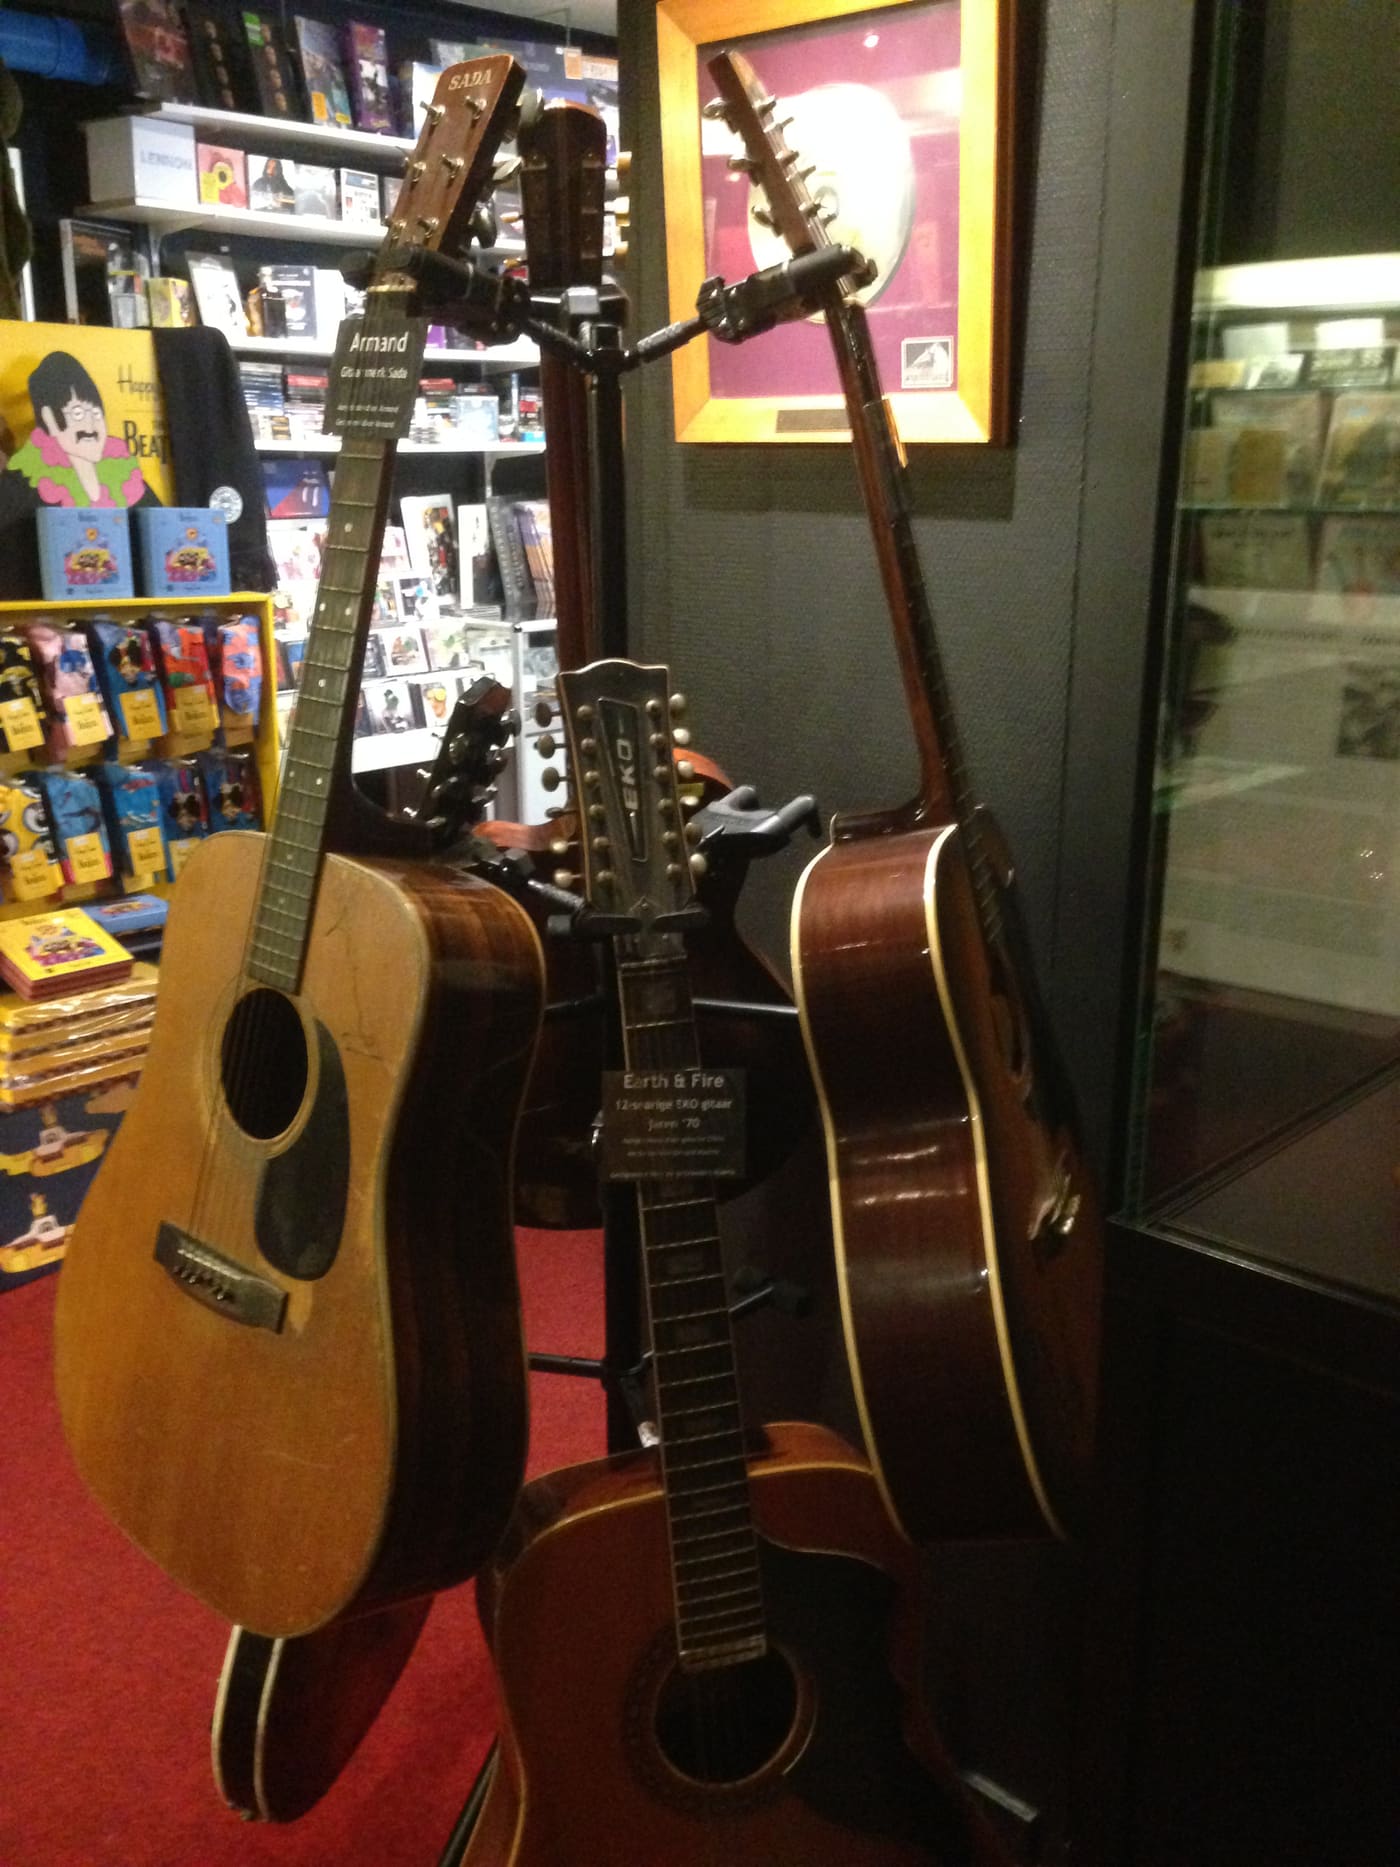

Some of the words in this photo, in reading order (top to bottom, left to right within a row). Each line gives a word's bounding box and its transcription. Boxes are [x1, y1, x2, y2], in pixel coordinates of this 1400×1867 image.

[448, 69, 492, 90] SADA
[349, 331, 409, 352] Armand
[616, 738, 639, 810] EKO
[623, 1073, 669, 1089] Earth
[674, 1074, 685, 1088] &
[691, 1073, 724, 1088] Fire
